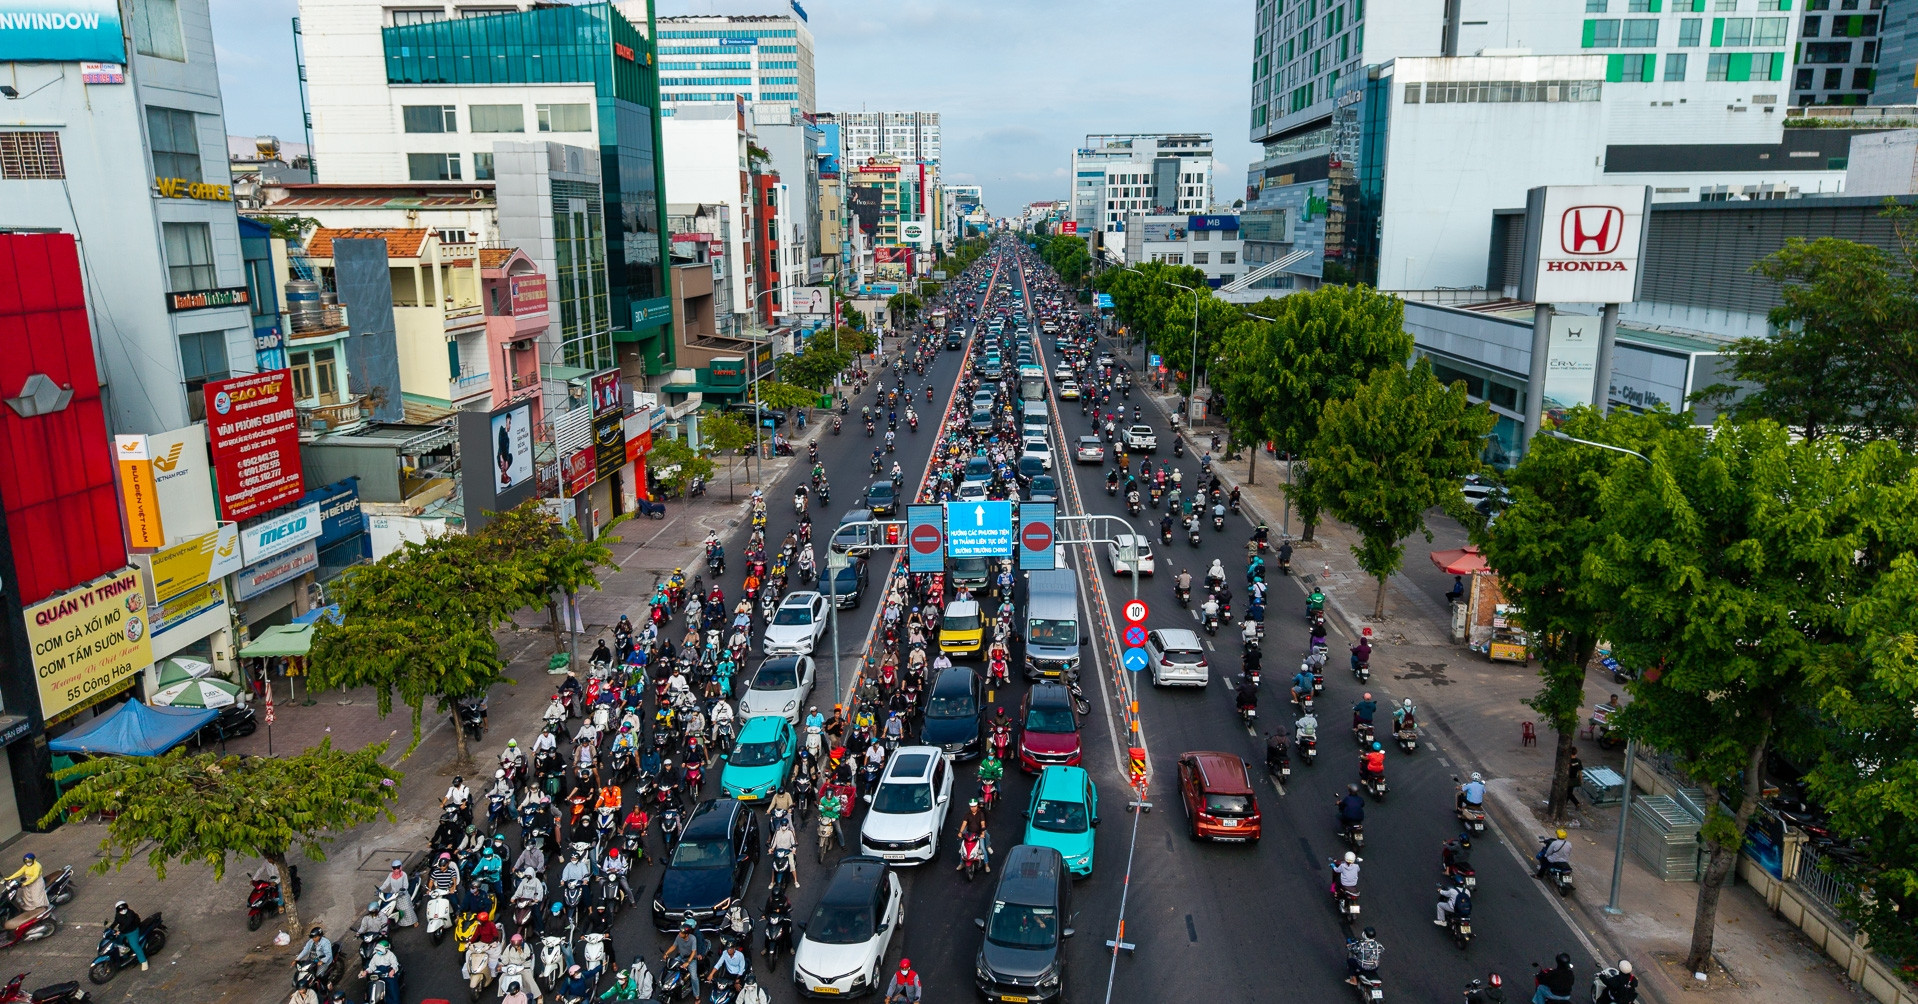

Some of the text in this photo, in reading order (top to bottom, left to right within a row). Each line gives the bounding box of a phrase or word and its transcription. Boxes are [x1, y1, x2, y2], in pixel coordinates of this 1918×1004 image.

[156, 176, 232, 201] WE OFFICE
[1546, 262, 1628, 271] HONDA
[230, 382, 282, 402] SAO VIỆT
[1622, 386, 1643, 406] Cộng
[217, 409, 294, 437] VĂN PHÒNG GHI DANH
[541, 464, 558, 483] BUFFE
[574, 458, 586, 472] MSB
[330, 503, 345, 518] BIẾT
[259, 516, 307, 547] MESO
[187, 544, 197, 552] NAM
[36, 600, 79, 626] QUÁN
[80, 592, 94, 608] YI
[95, 575, 137, 601] TRINH
[36, 607, 121, 656] CƠM GÀ XỐI MỠ
[39, 630, 125, 679] CƠM TẤM SƯỜN
[67, 662, 132, 702] 55 Cộng Hòa
